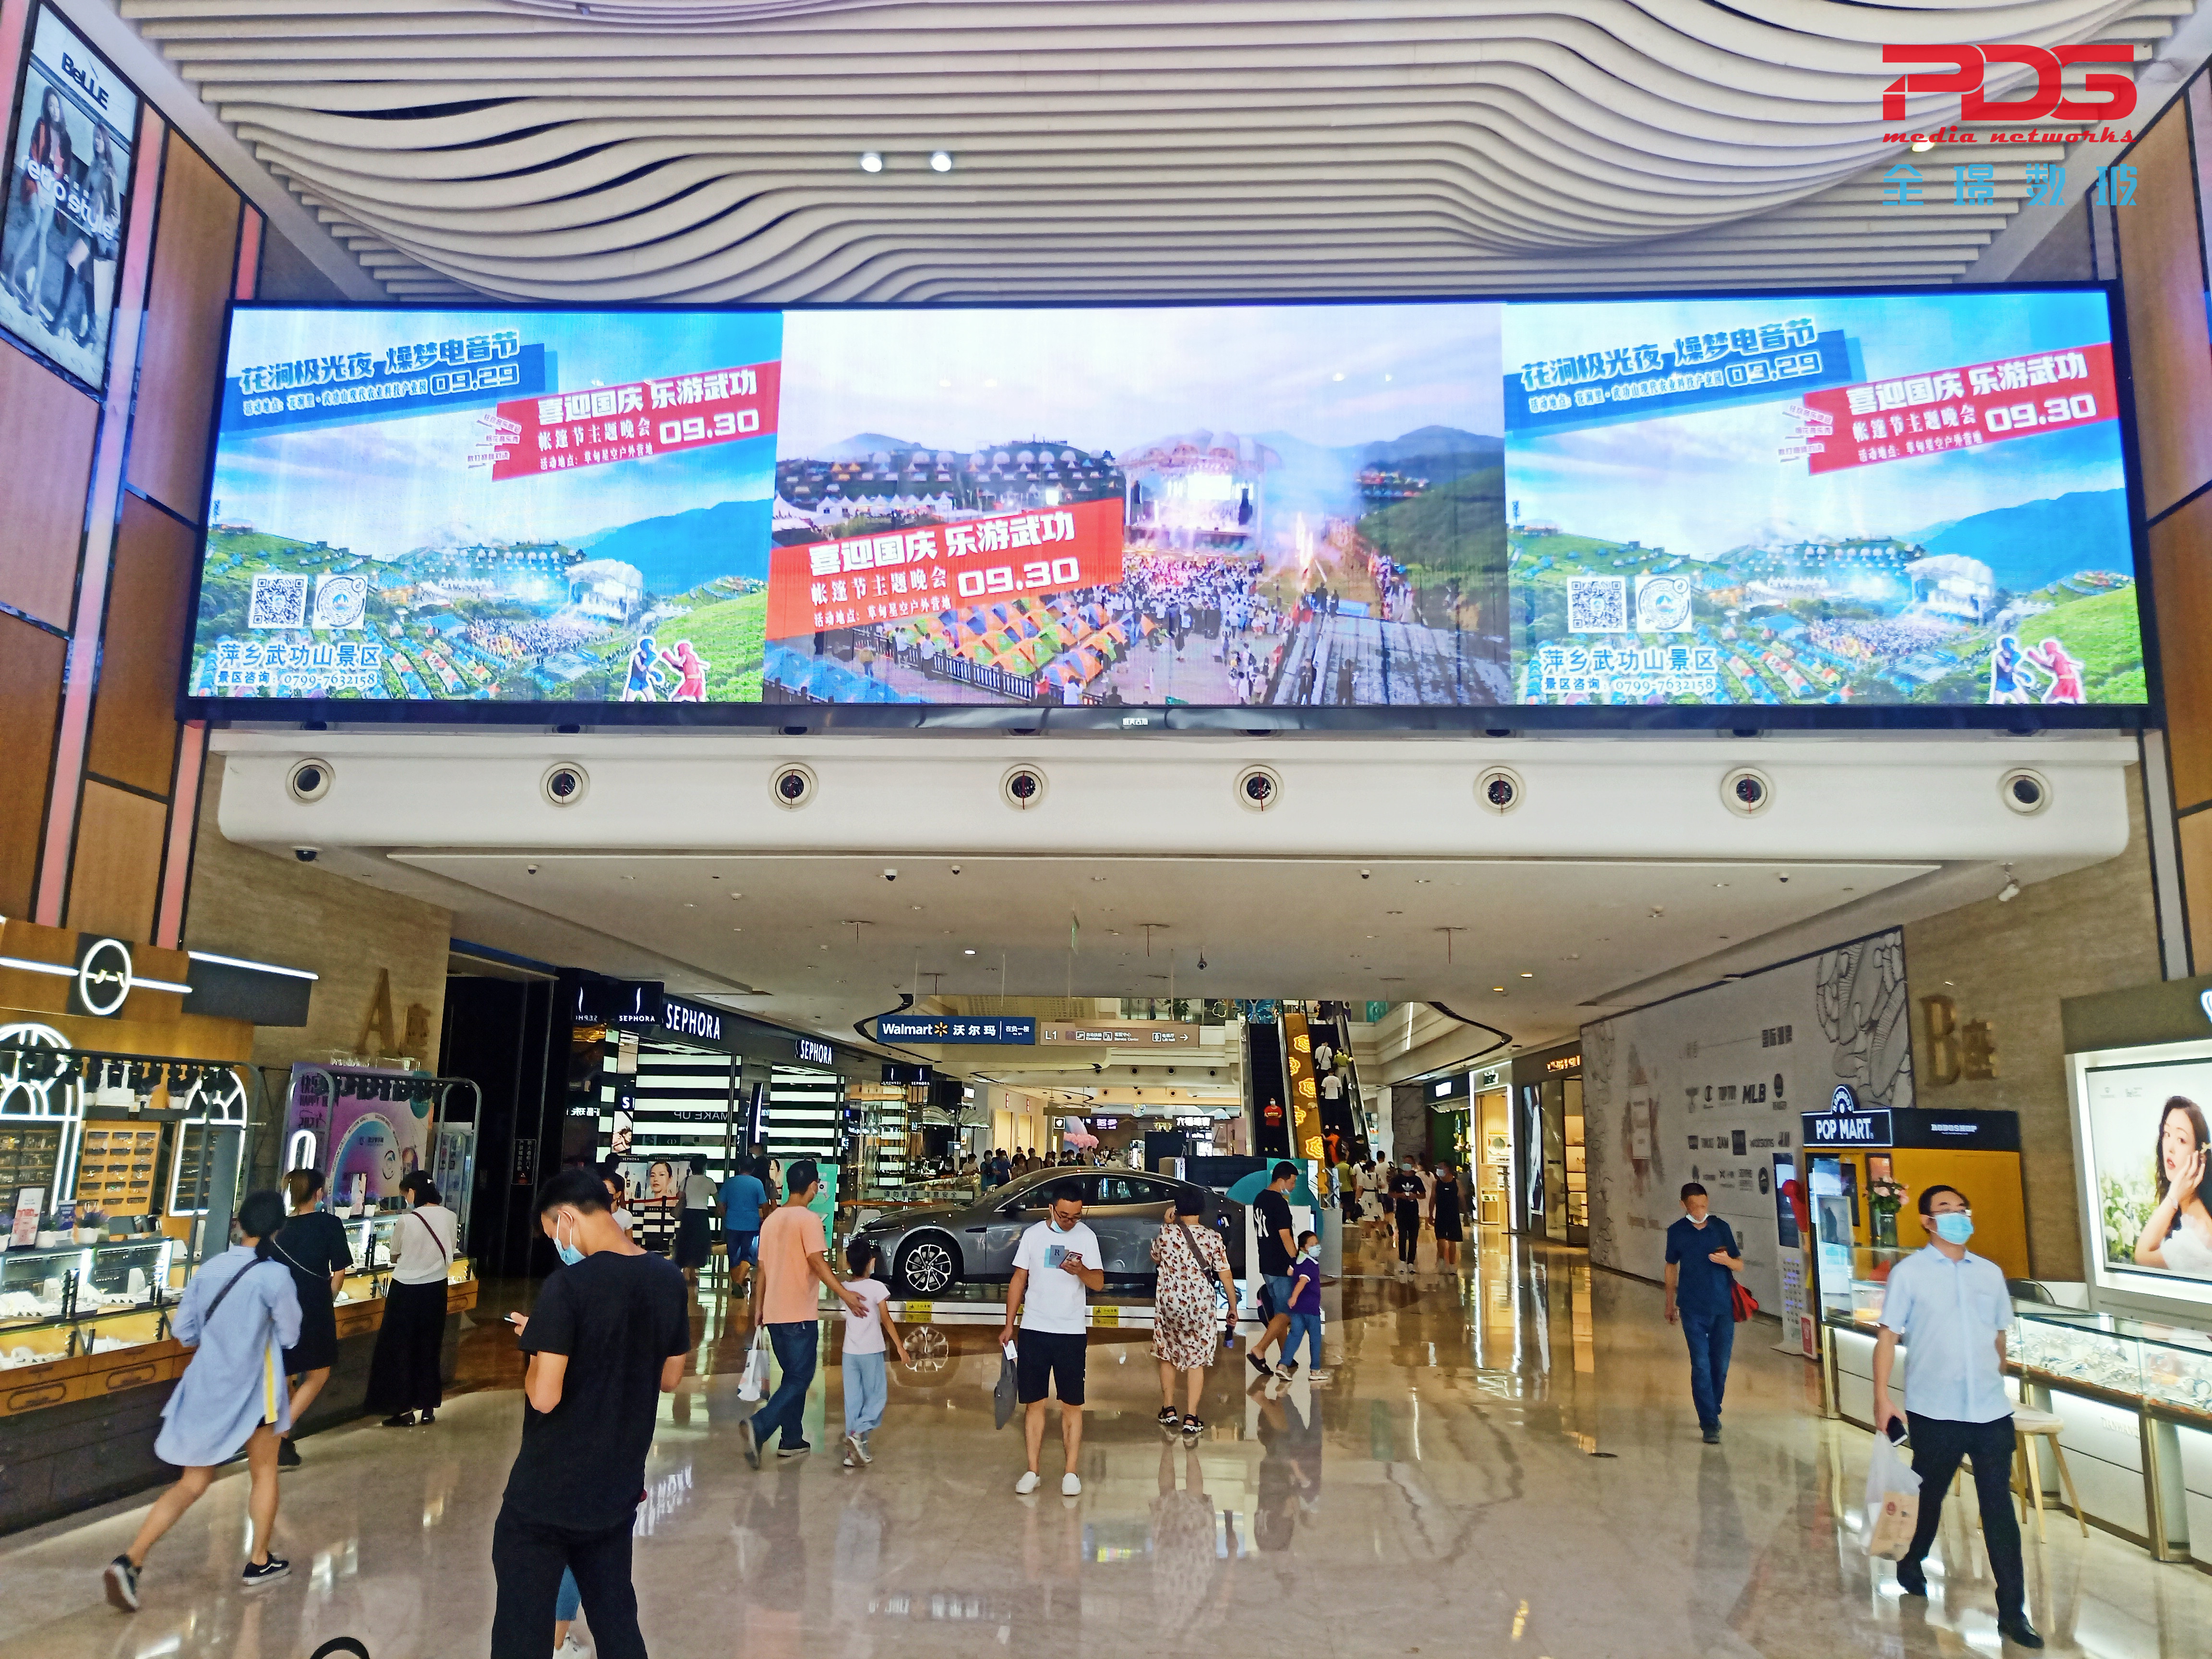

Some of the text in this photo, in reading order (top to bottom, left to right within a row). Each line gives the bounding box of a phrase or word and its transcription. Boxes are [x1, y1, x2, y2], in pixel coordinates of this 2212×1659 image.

[21, 155, 66, 201] retro
[68, 194, 114, 240] style
[240, 351, 374, 395] 花涧极光夜
[431, 363, 520, 397] 09.29
[1520, 343, 1663, 392] 花涧极光夜
[1846, 372, 1965, 415] 喜迎国庆
[1968, 351, 2089, 396] 乐游武功
[538, 368, 757, 425] 喜迎国庆 乐游武功
[1984, 394, 2098, 433] 09.30
[659, 409, 760, 445] 09.30
[809, 510, 1075, 577] 喜迎国庆 乐游武功
[811, 566, 948, 607] 帐篷节主题晚会
[958, 556, 1080, 598] 09.30
[218, 642, 383, 668] 萍乡武功山景区
[1543, 648, 1717, 672] 萍乡武功山景区
[284, 673, 377, 688] 0799-7632158
[1616, 678, 1714, 693] 0799-7632158
[666, 1002, 721, 1041] SEPHORA
[882, 1023, 933, 1035] Walmart
[952, 1024, 996, 1036] 沃尔玛
[1045, 1031, 1057, 1040] L1
[800, 1039, 832, 1065] SEPHORA
[1743, 1083, 1766, 1104] MLB
[1815, 1118, 1871, 1139] POP MART
